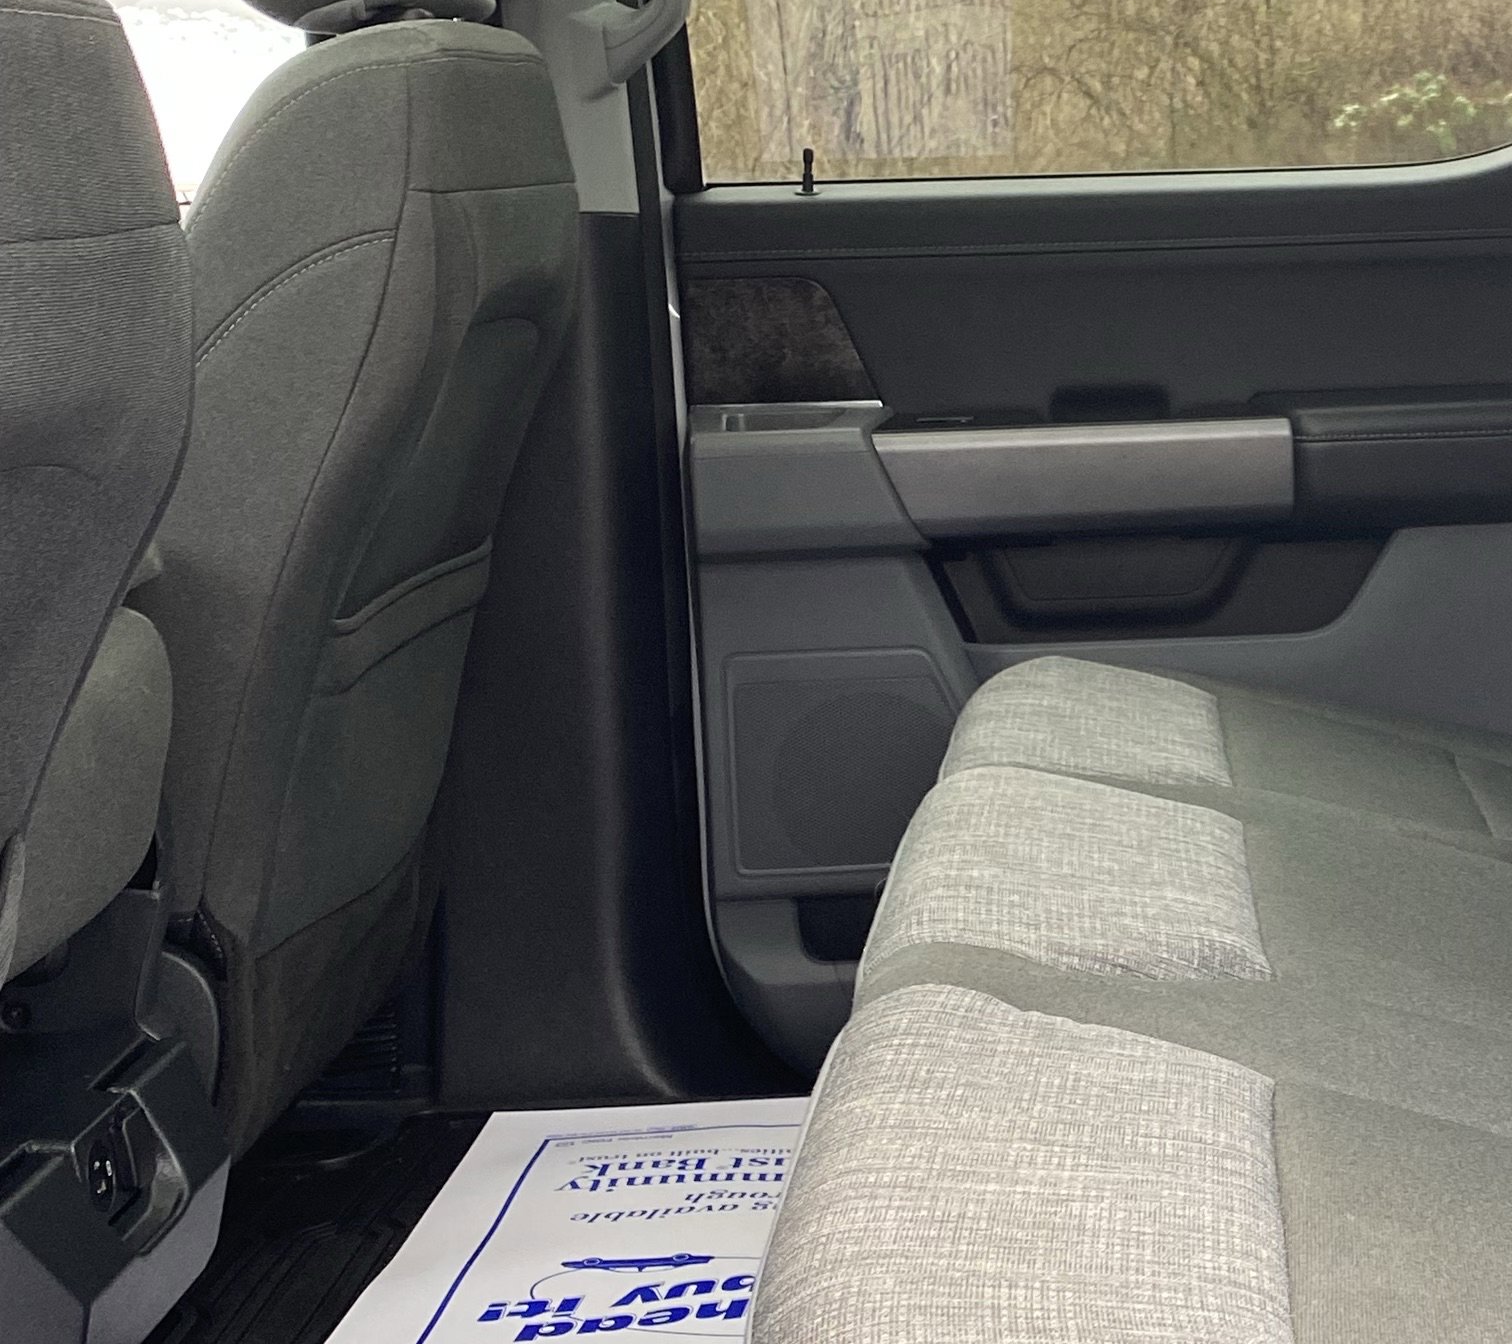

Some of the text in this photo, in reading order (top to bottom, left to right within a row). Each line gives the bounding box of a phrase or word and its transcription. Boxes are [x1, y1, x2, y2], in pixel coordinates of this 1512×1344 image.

[580, 1157, 713, 1177] Bank
[570, 1204, 739, 1224] available
[476, 1296, 586, 1322] it!
